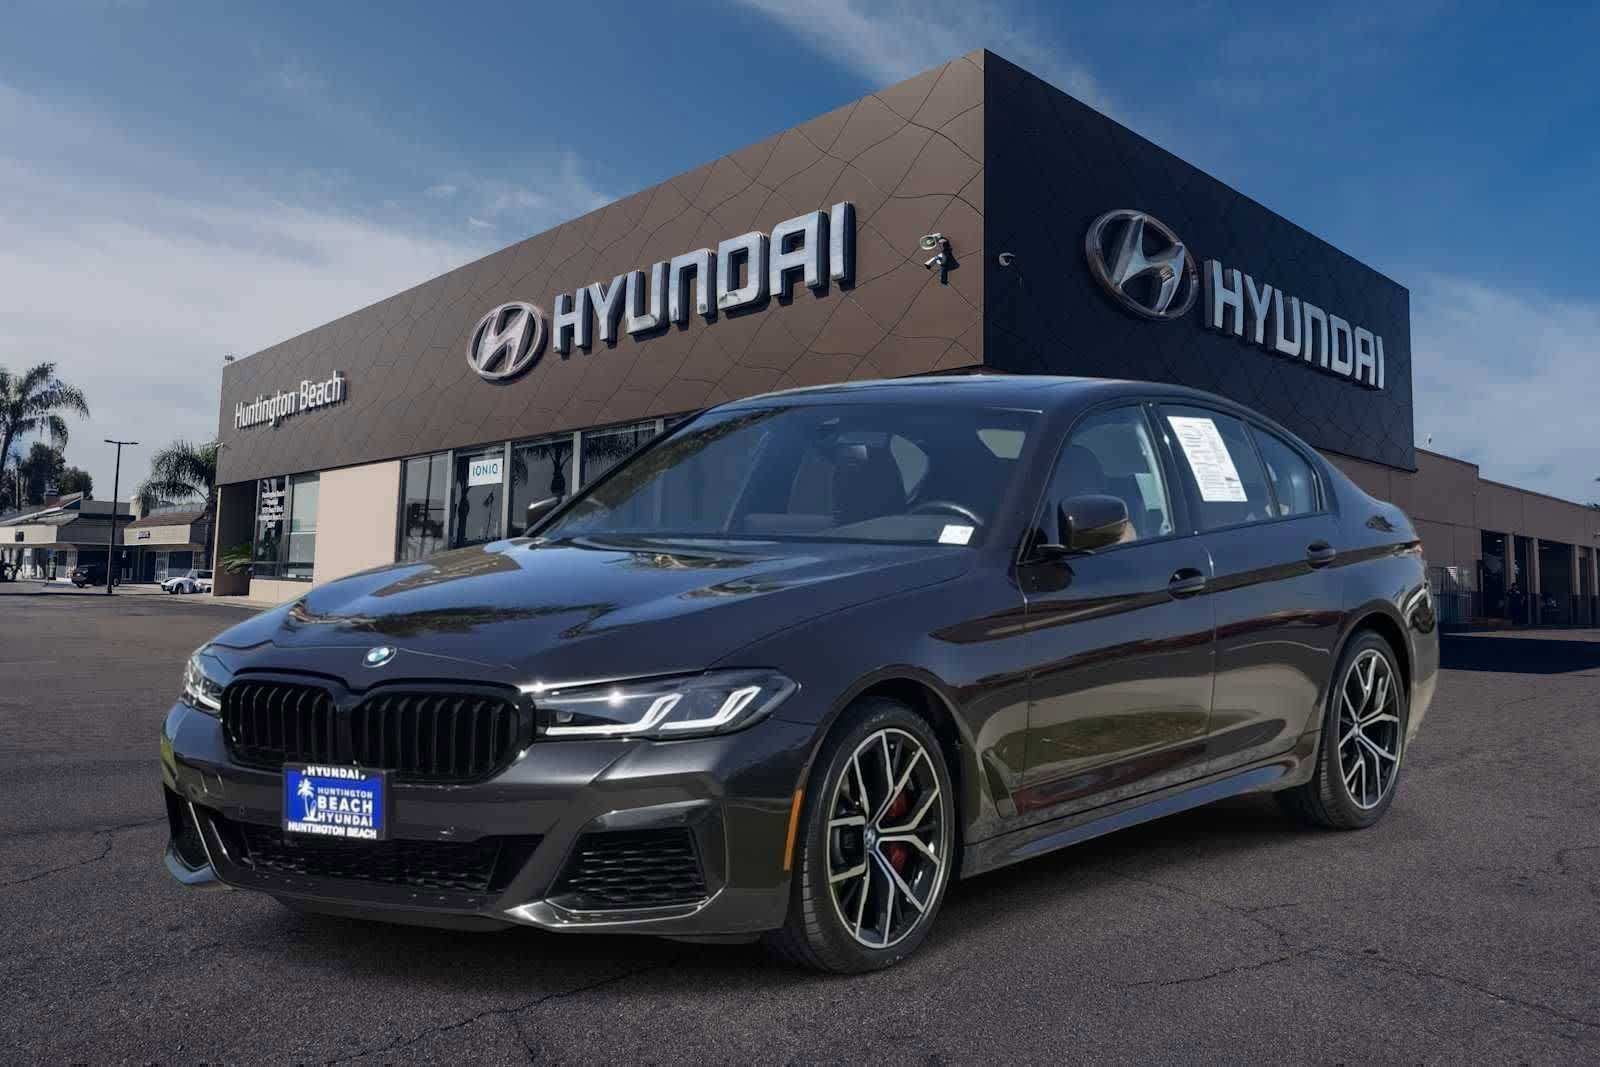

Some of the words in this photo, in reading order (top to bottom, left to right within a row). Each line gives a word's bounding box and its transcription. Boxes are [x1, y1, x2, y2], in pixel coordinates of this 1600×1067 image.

[553, 201, 850, 353] HYUNDAI
[1206, 258, 1386, 390] HYUNDAI
[234, 389, 297, 430] Huntington
[299, 370, 342, 411] Beach
[307, 765, 360, 780] HYUNDAI
[317, 786, 373, 799] HUNTINGTON
[317, 795, 373, 814] BEACH
[317, 812, 373, 827] HYUNDAI
[287, 821, 345, 837] HUNTINGTON
[346, 826, 377, 839] BEACH
